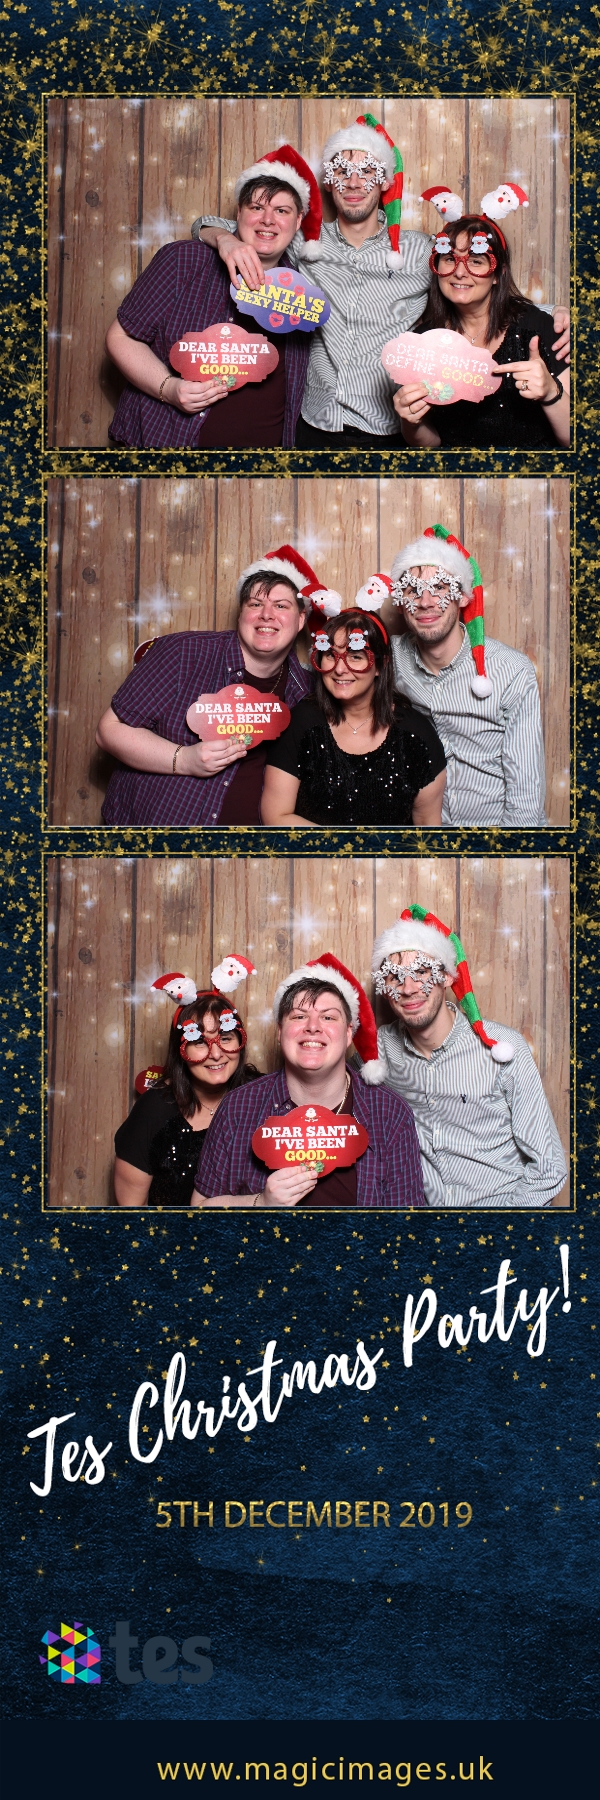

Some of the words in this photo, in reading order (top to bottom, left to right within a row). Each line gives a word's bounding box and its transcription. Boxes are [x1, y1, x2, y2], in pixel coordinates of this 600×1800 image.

[235, 291, 272, 308] SEXY
[272, 302, 320, 323] HELPER
[179, 342, 217, 352] DEAR
[220, 343, 270, 354] SANTA
[190, 353, 218, 363] I'VE
[221, 354, 258, 364] BEEN
[396, 343, 436, 362] DEAR
[440, 353, 489, 375] SANTA
[199, 364, 249, 375] GOOD...
[385, 353, 437, 376] DEFINE
[441, 366, 494, 390] GOOD...
[195, 703, 232, 714] DEAR
[235, 703, 283, 713] SANTA
[207, 714, 234, 724] I'VE
[236, 713, 271, 723] BEEN
[216, 724, 264, 735] GOOD...
[261, 1126, 303, 1138] DEAR
[306, 1124, 359, 1137] SANTA
[274, 1139, 305, 1150] I'VE
[307, 1137, 346, 1149] BEEN
[284, 1149, 337, 1161] GOOD...
